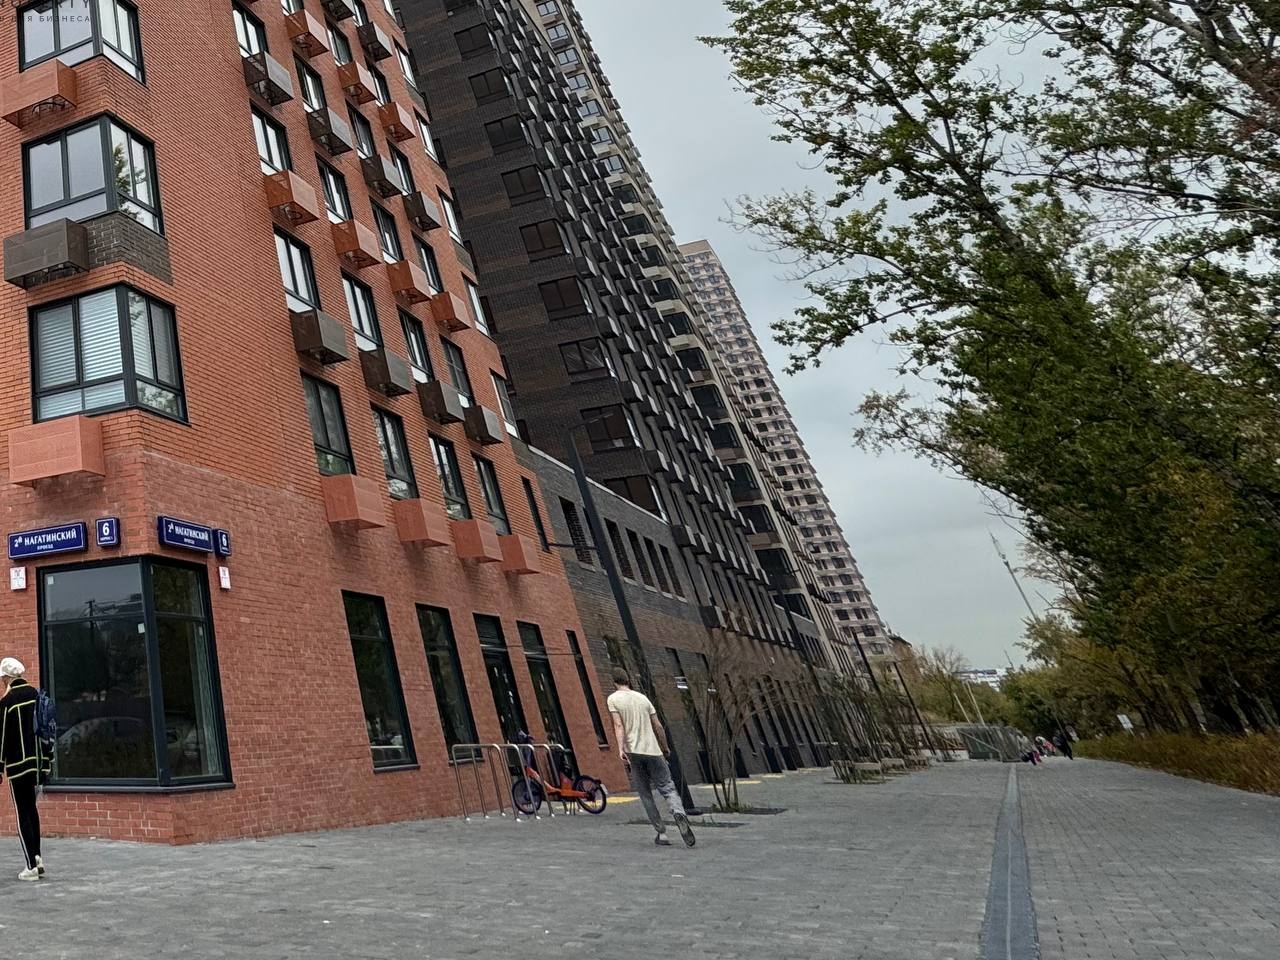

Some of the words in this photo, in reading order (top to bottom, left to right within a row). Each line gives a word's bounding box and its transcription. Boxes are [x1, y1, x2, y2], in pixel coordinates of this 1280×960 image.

[102, 522, 110, 536] 6
[24, 528, 77, 546] НАГАТИНСКИЙ
[222, 534, 227, 546] 6
